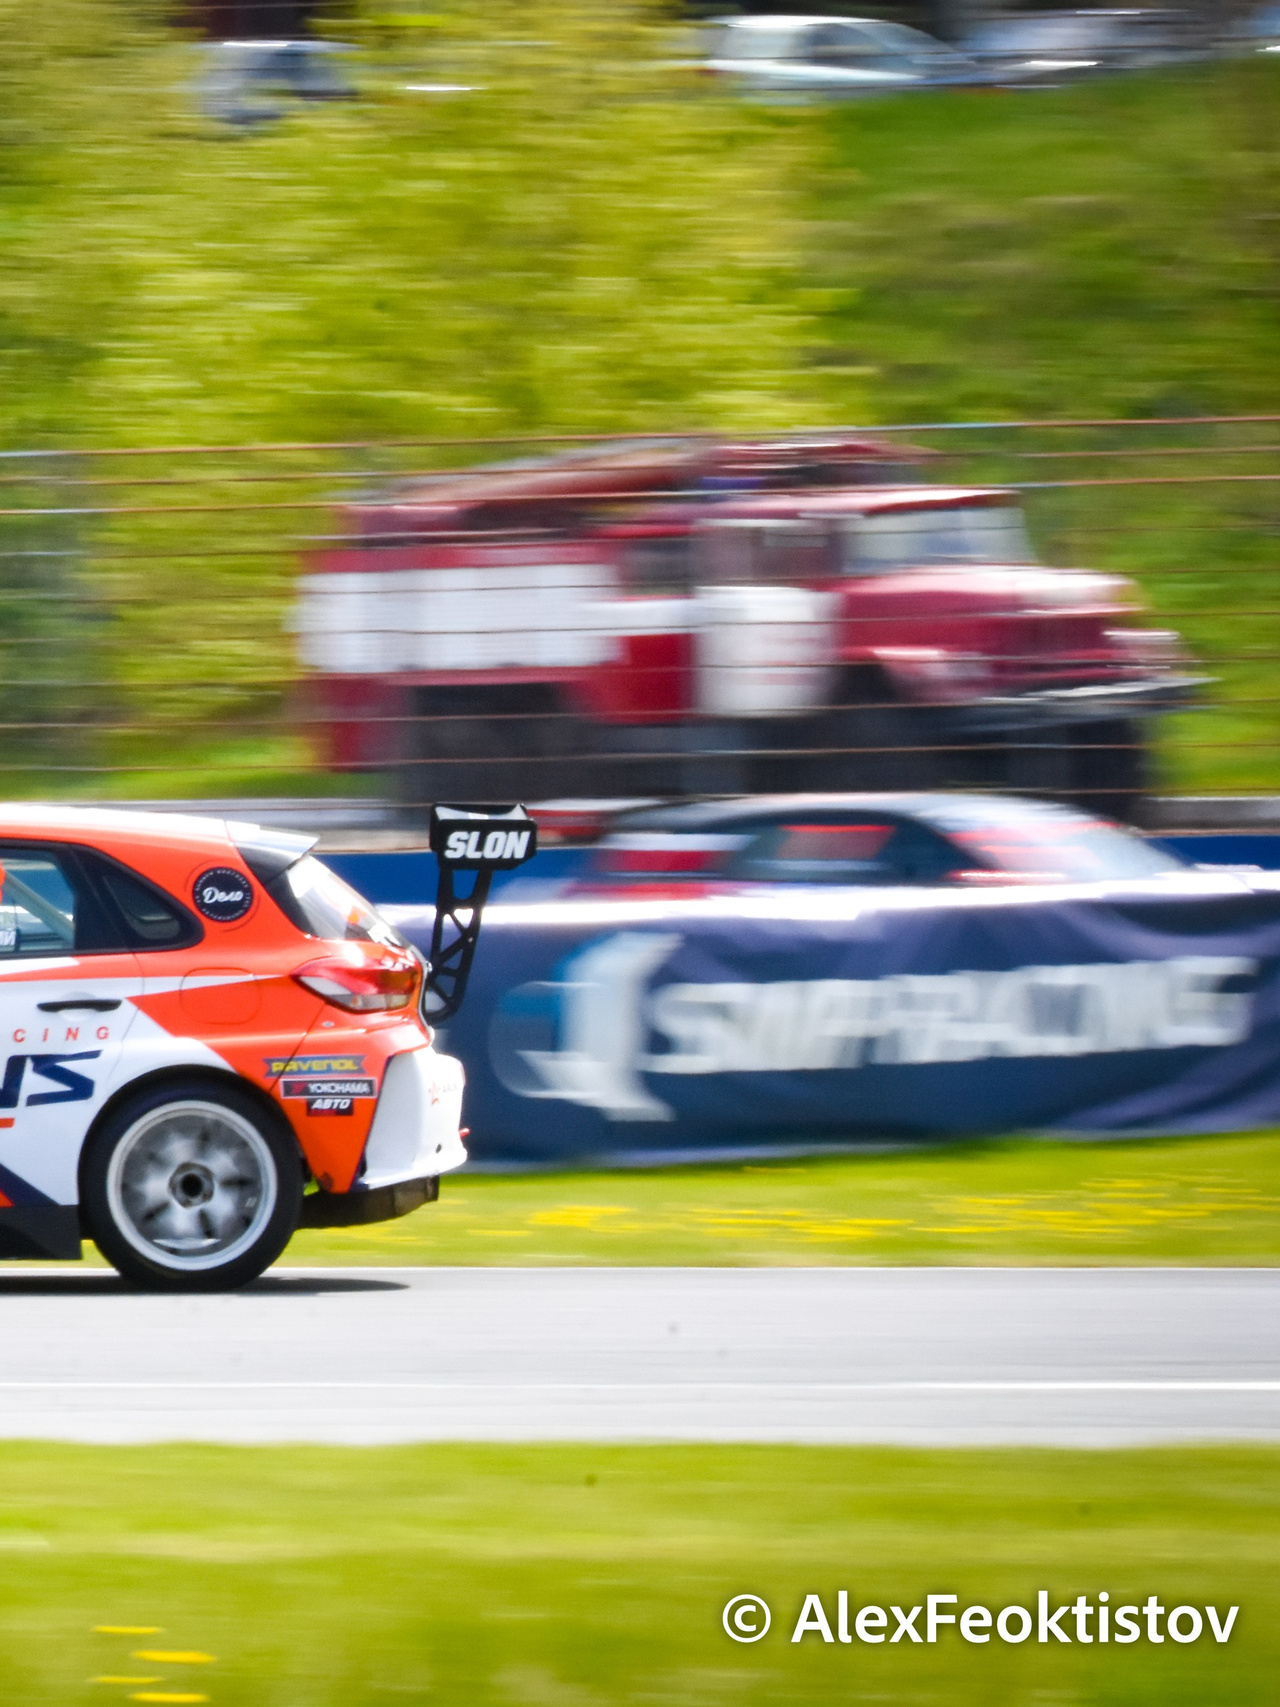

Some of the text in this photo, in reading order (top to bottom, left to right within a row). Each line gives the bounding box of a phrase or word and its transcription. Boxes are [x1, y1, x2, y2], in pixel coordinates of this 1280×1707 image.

[444, 831, 531, 859] SLON
[307, 1081, 370, 1095] YOKOHAMA
[311, 1098, 351, 1110] АВТО
